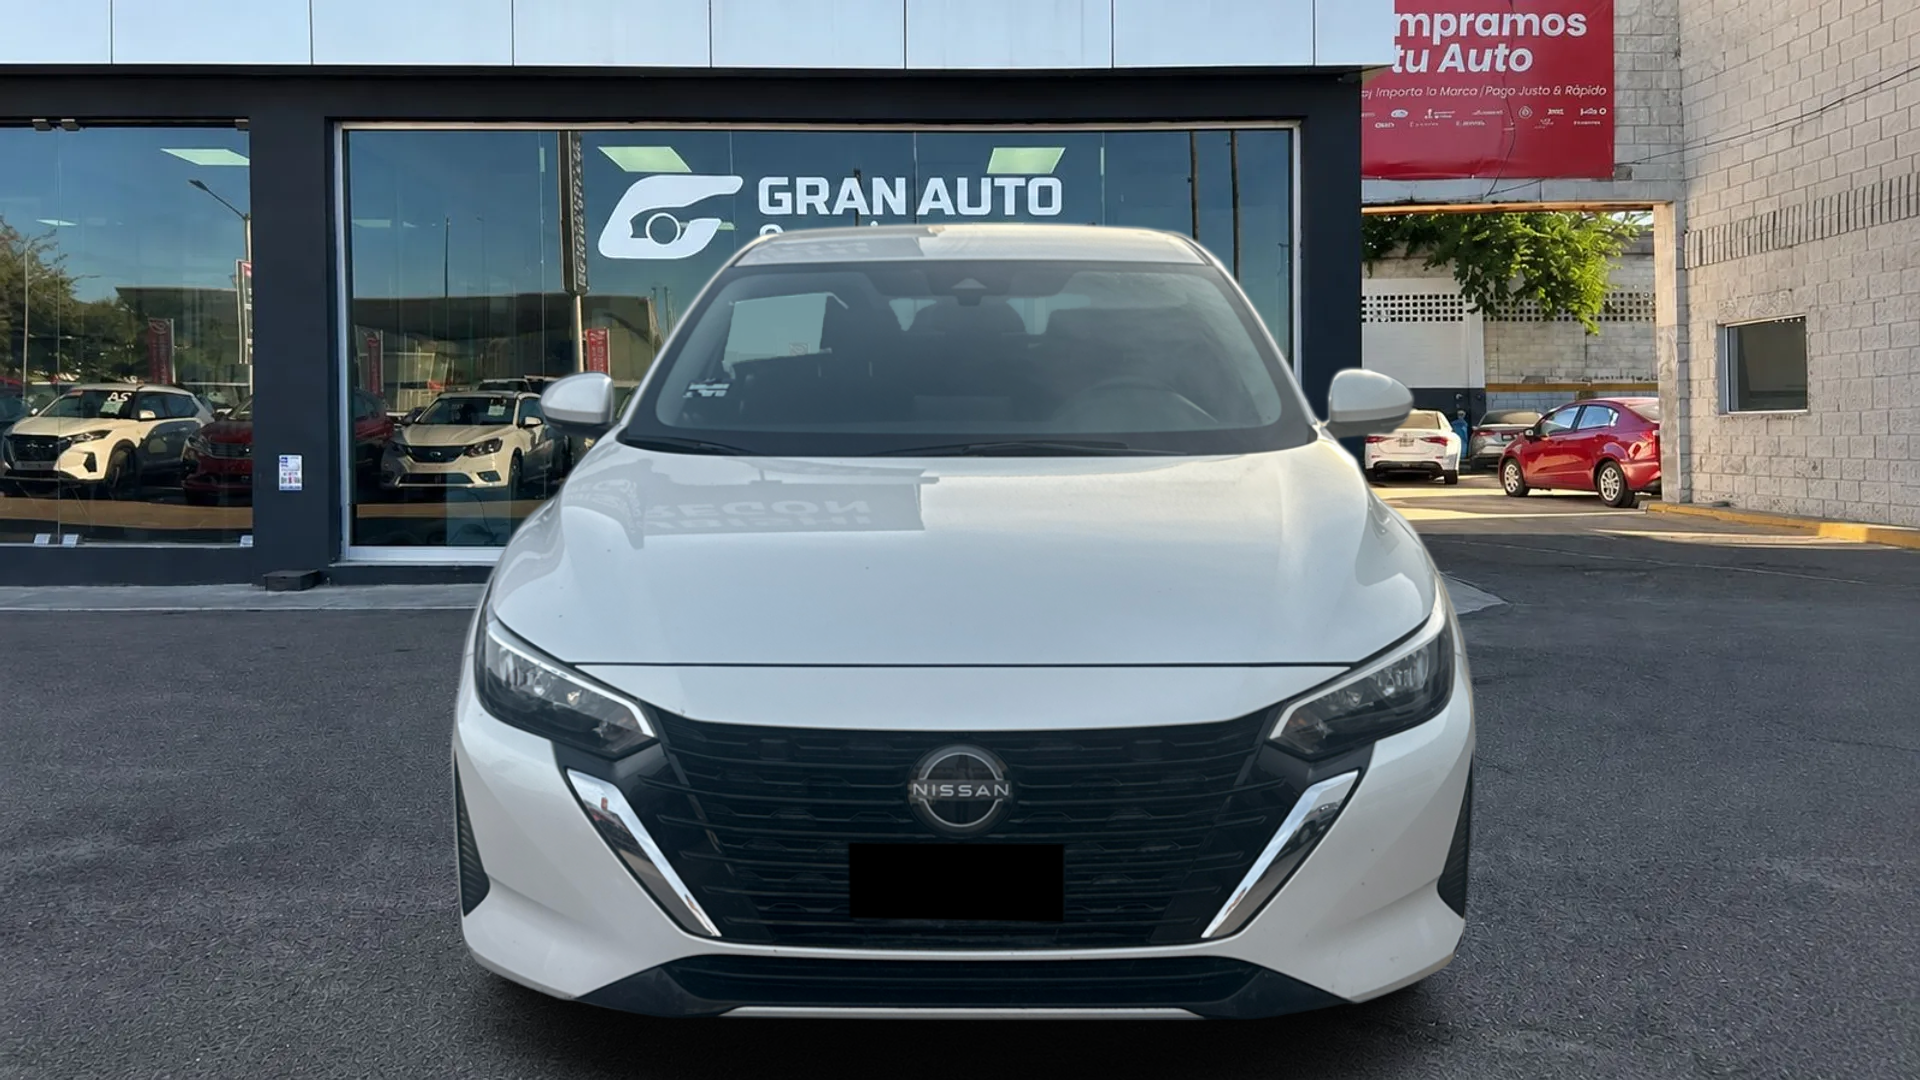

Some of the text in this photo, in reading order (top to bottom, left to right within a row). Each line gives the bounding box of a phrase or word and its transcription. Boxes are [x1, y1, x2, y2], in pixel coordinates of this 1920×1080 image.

[1392, 43, 1534, 73] tu Auto
[1375, 87, 1423, 99] Importa
[1426, 86, 1437, 97] la
[1439, 86, 1478, 97] Marca
[1518, 85, 1551, 97] Justo
[1552, 85, 1562, 96] &
[1564, 84, 1607, 98] Rápido
[758, 176, 1062, 215] GRAN AUTO
[912, 783, 1010, 797] NISSAN
